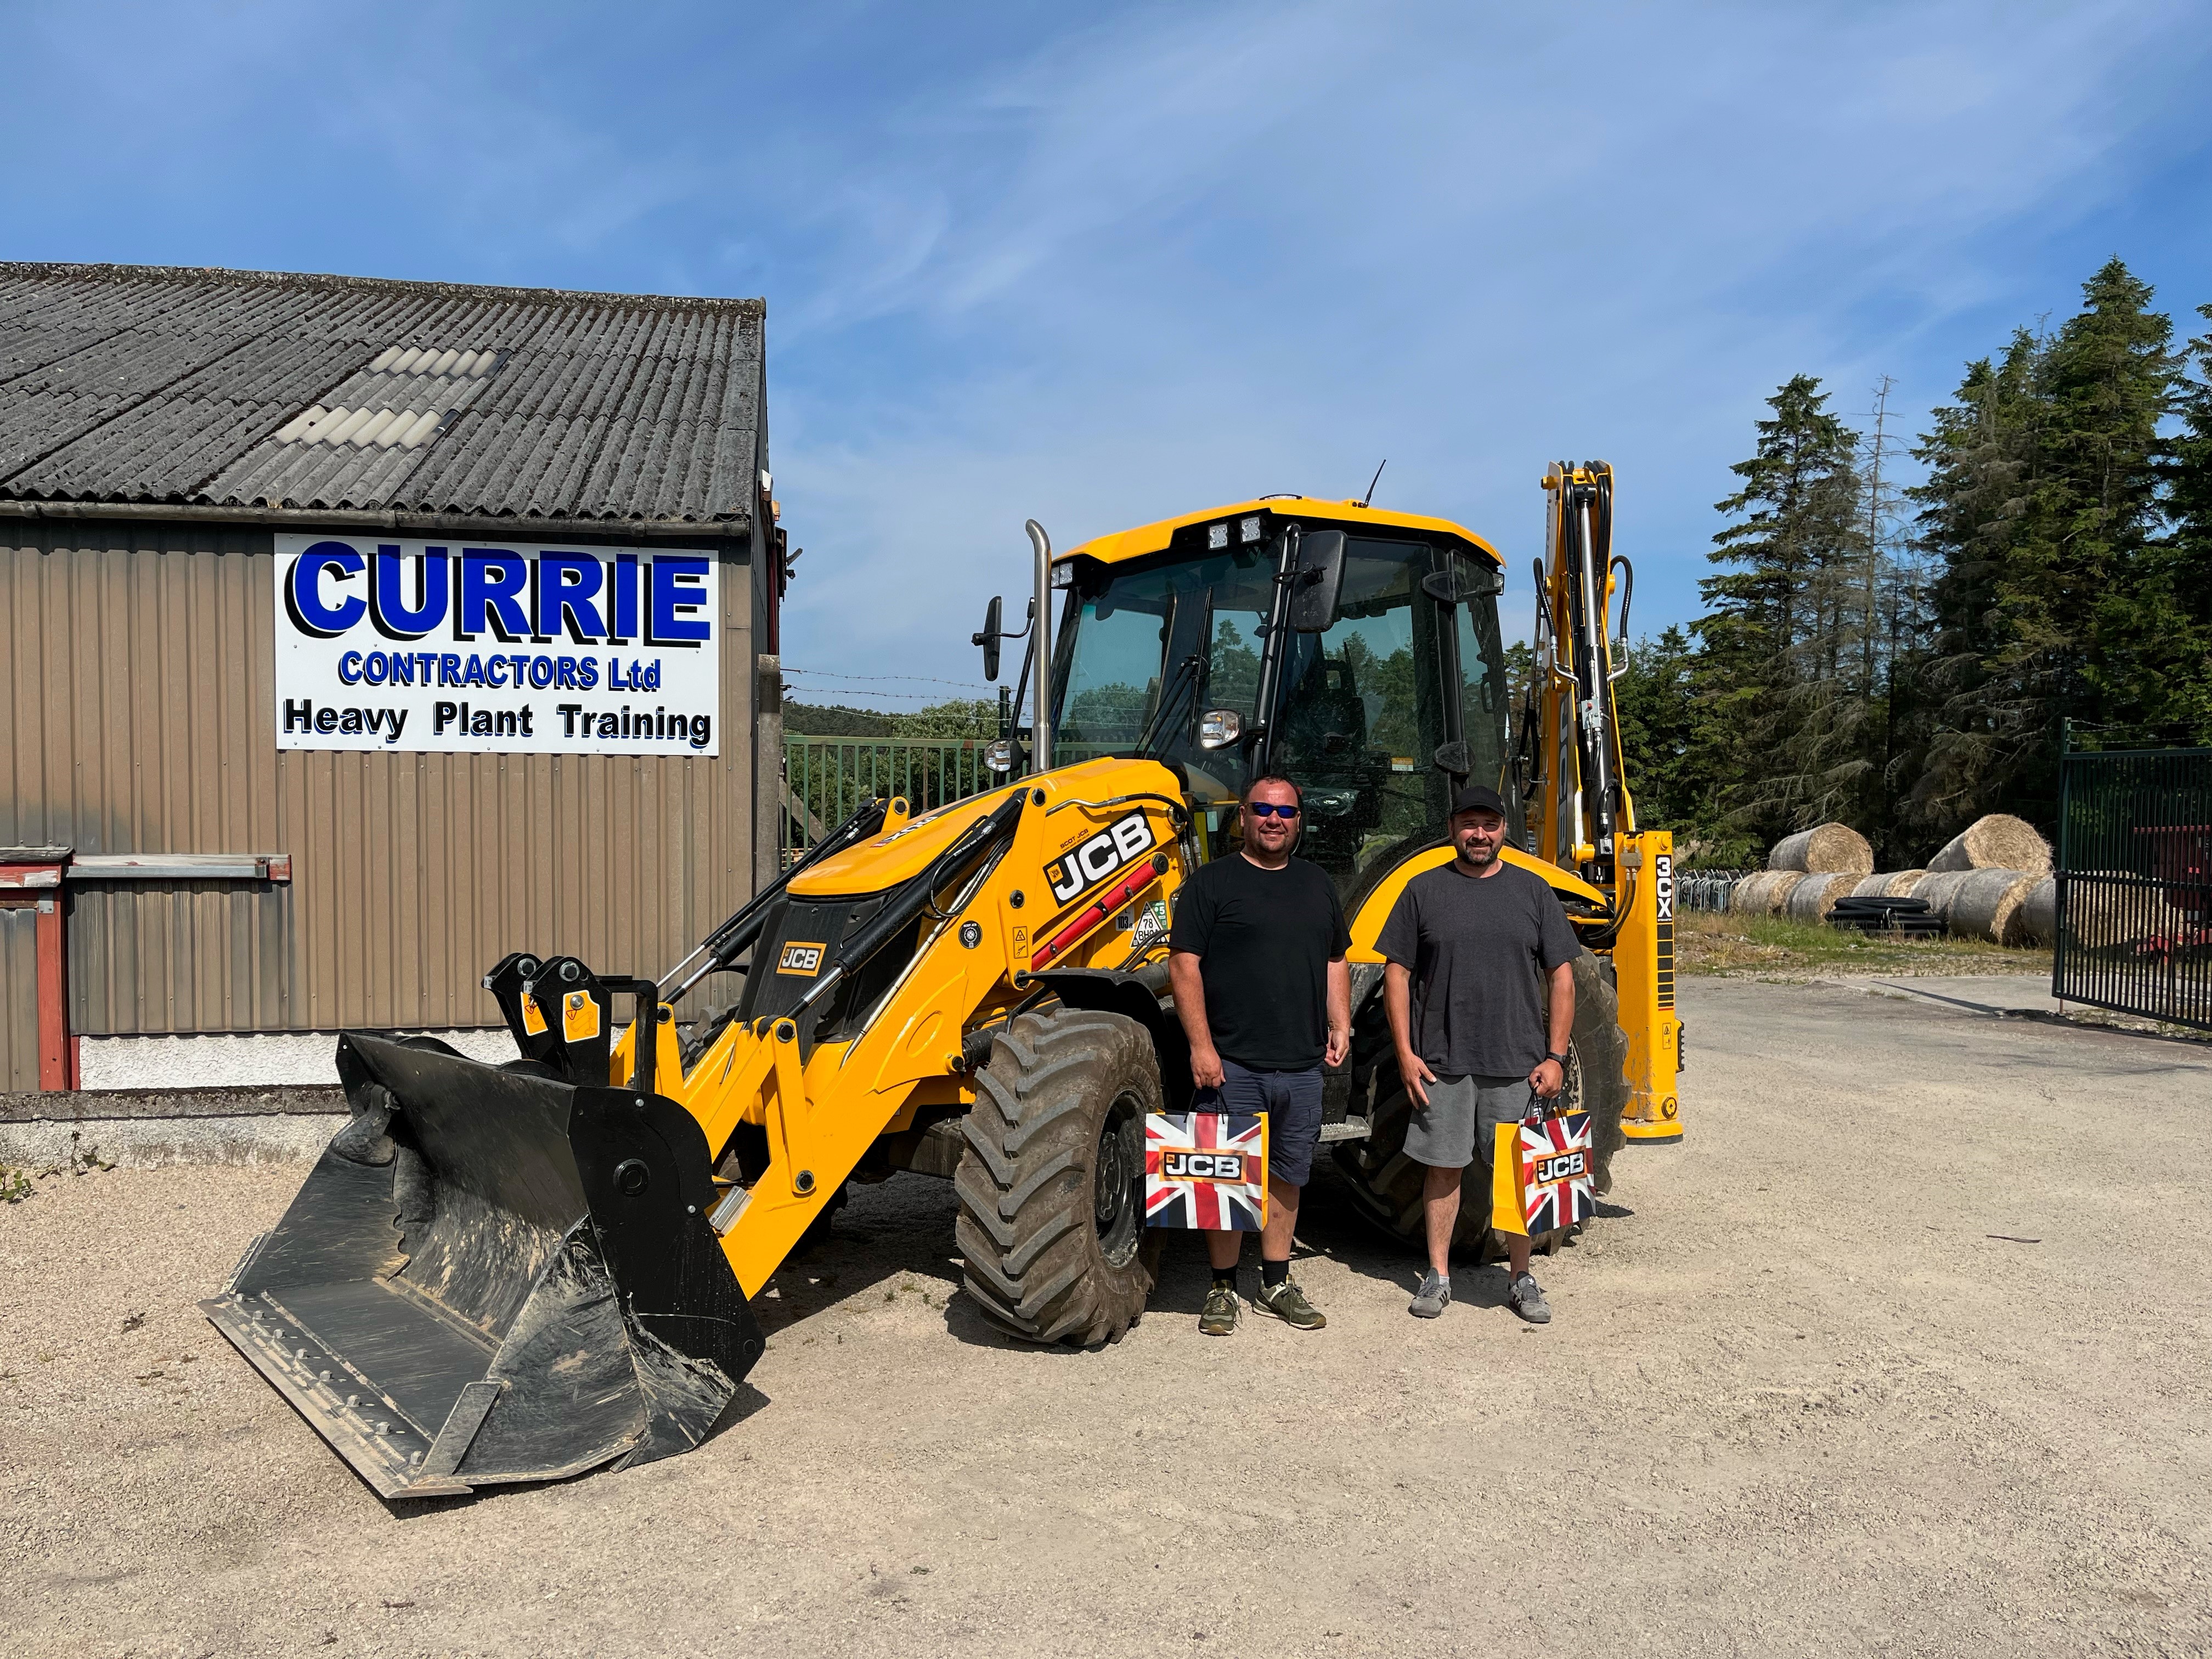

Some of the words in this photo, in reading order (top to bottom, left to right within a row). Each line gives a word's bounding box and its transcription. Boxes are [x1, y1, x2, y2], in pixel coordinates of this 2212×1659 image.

[284, 541, 710, 648] CURRIE
[338, 651, 599, 691] CONTRACTORS
[608, 659, 661, 691] Ltd
[284, 699, 408, 743] Heavy
[433, 702, 534, 737] Plant
[558, 704, 711, 748] Training
[1077, 828, 1088, 838] JCB
[1054, 814, 1152, 901] JCB
[1657, 857, 1672, 917] 3CX
[1159, 906, 1165, 915] 5
[1117, 916, 1128, 929] 103
[1143, 918, 1153, 929] 78
[1138, 929, 1158, 940] BH
[782, 949, 819, 969] JCB
[1166, 1154, 1240, 1177] JCB
[1538, 1152, 1584, 1182] JCB
